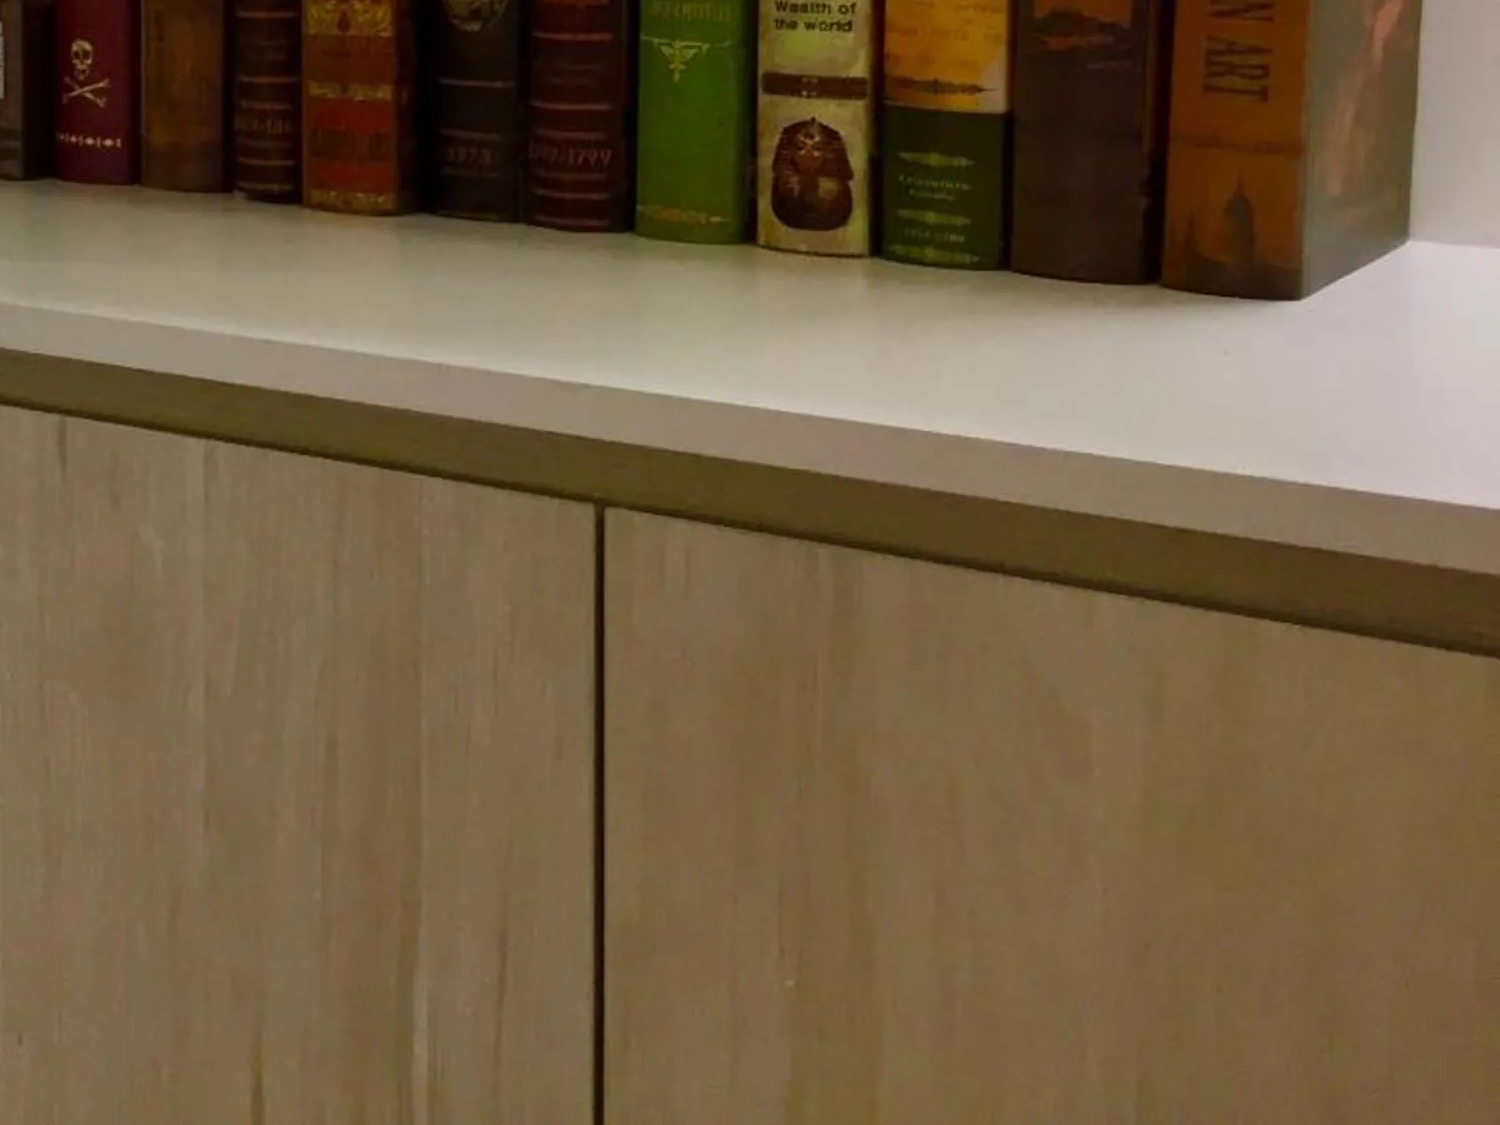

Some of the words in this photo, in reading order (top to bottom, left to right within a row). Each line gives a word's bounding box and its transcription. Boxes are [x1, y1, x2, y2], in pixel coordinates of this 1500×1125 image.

[773, 0, 832, 16] Wealth
[837, 1, 858, 16] of
[773, 17, 799, 31] the
[803, 18, 854, 33] world
[1202, 33, 1275, 104] ART
